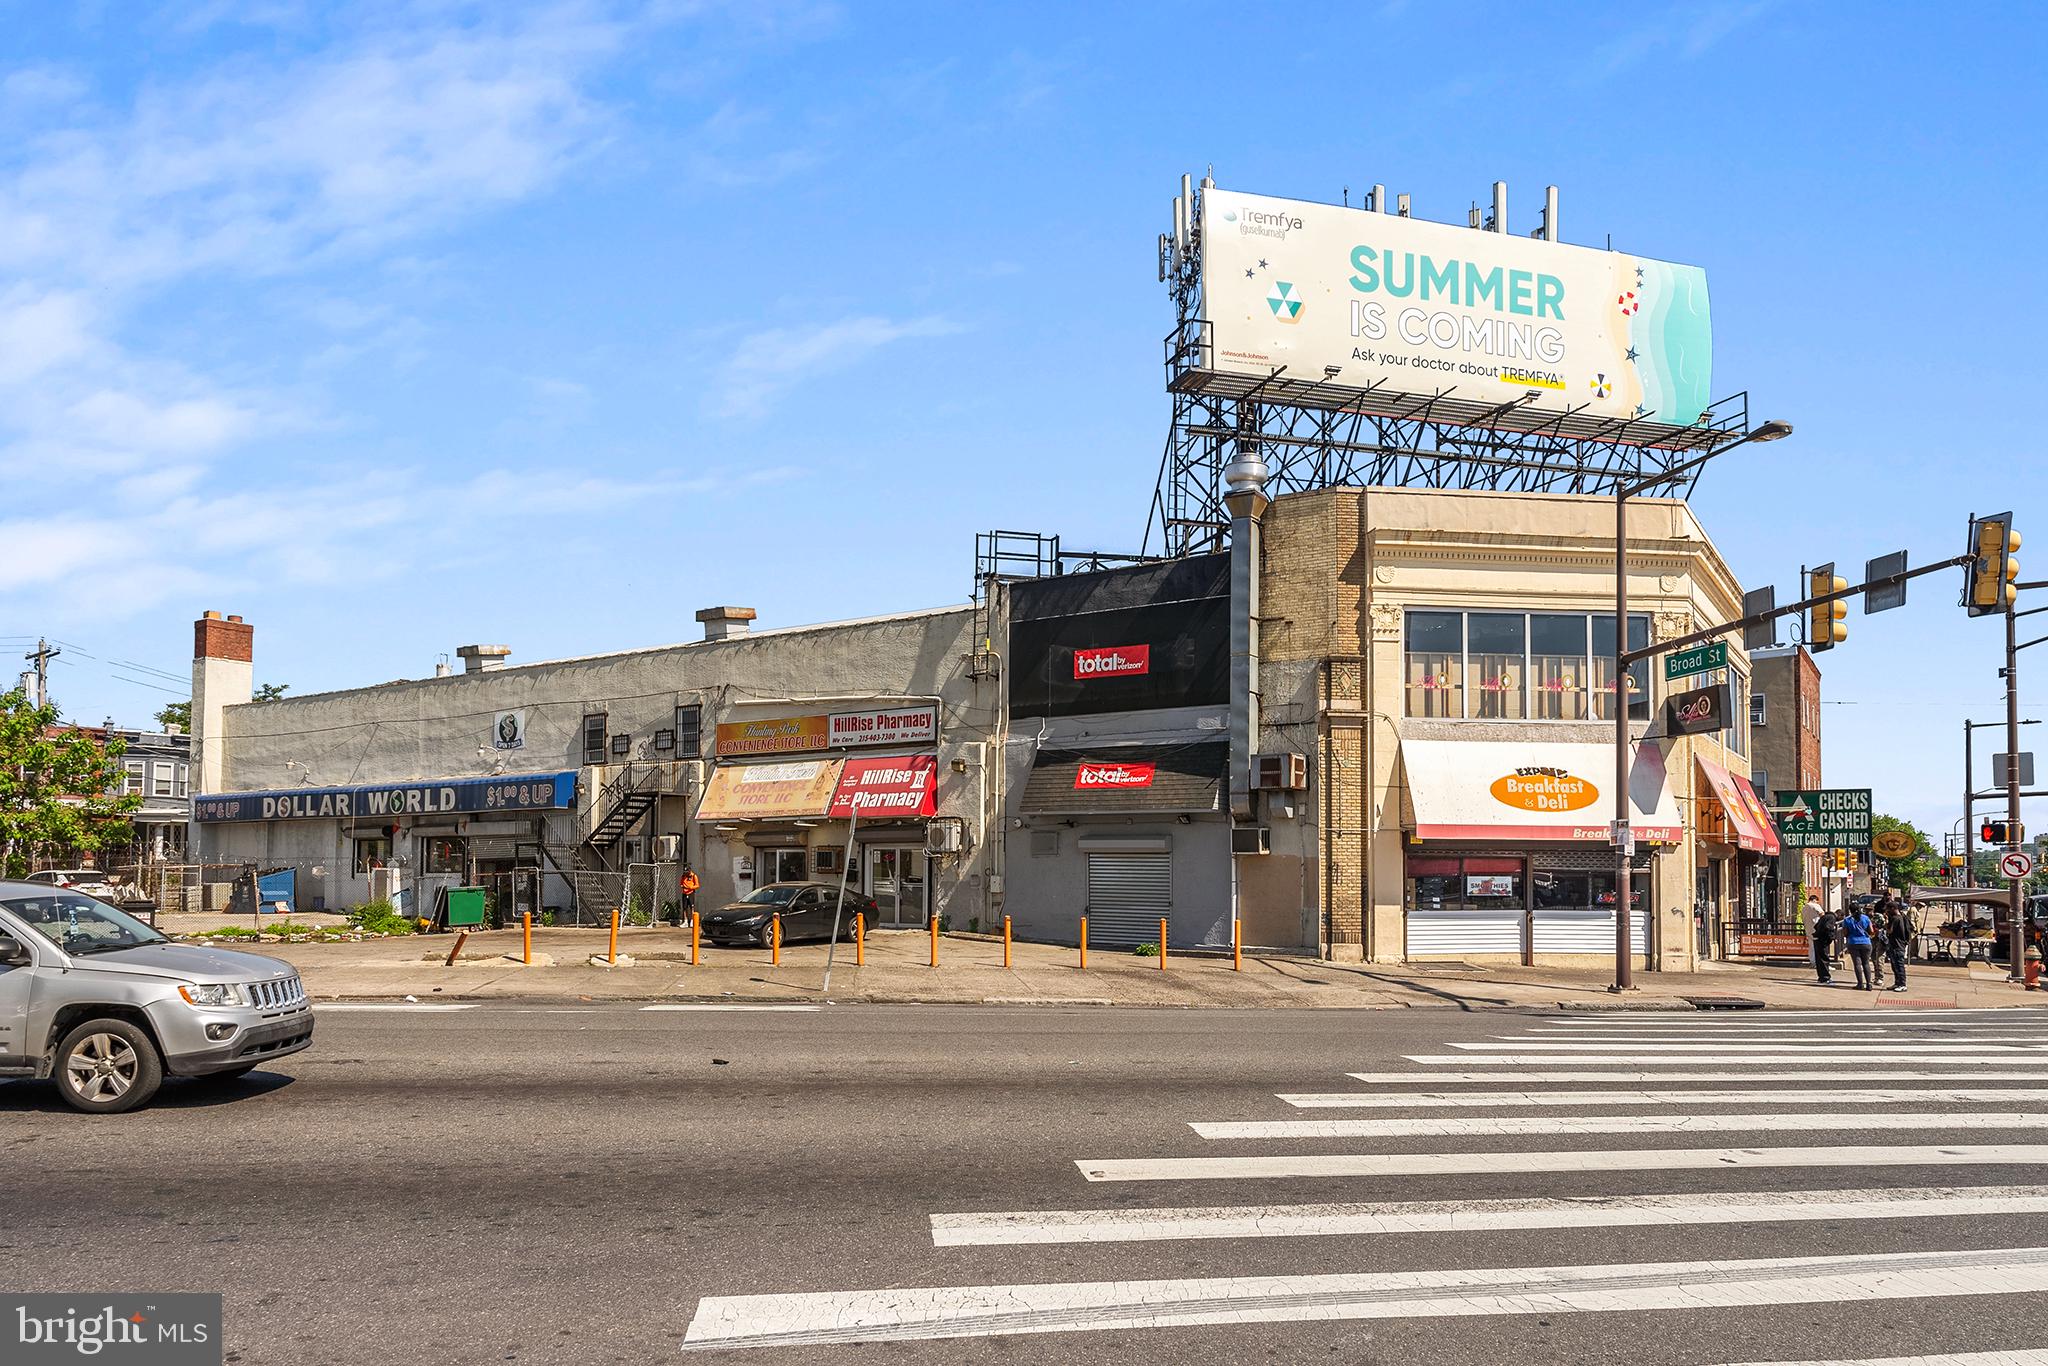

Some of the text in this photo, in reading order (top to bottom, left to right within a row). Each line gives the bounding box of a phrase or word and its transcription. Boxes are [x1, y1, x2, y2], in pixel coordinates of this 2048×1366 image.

[1241, 207, 1303, 232] Tremfya
[1348, 245, 1566, 321] SUMMER
[1350, 300, 1565, 363] IS COMING
[1352, 347, 1376, 362] Ask
[1379, 352, 1408, 366] your
[1412, 355, 1456, 371] doctor
[1459, 362, 1498, 377] about
[1078, 653, 1118, 673] total
[1117, 662, 1142, 670] verizon
[1670, 648, 1721, 673] Broad St
[834, 713, 932, 733] HillRise Pharmacy
[720, 734, 826, 754] CONVENIENCE STORE LLC
[860, 768, 913, 785] HillRise
[1081, 767, 1123, 784] total
[519, 785, 530, 805] &
[532, 783, 553, 804] UP
[1506, 778, 1584, 794] Breakfast
[262, 787, 456, 818] DOLLAR WORLD
[851, 791, 925, 809] Pharmacy
[1524, 793, 1568, 809] & Deli
[1819, 792, 1869, 810] CHECKS
[225, 801, 240, 818] UP
[1785, 822, 1814, 830] ACE
[1819, 812, 1869, 829] CASHED
[1636, 830, 1644, 838] &
[1645, 828, 1670, 839] Deli
[1805, 833, 1829, 845] CARDS
[1834, 833, 1848, 845] PAY
[1849, 832, 1869, 845] BILLS
